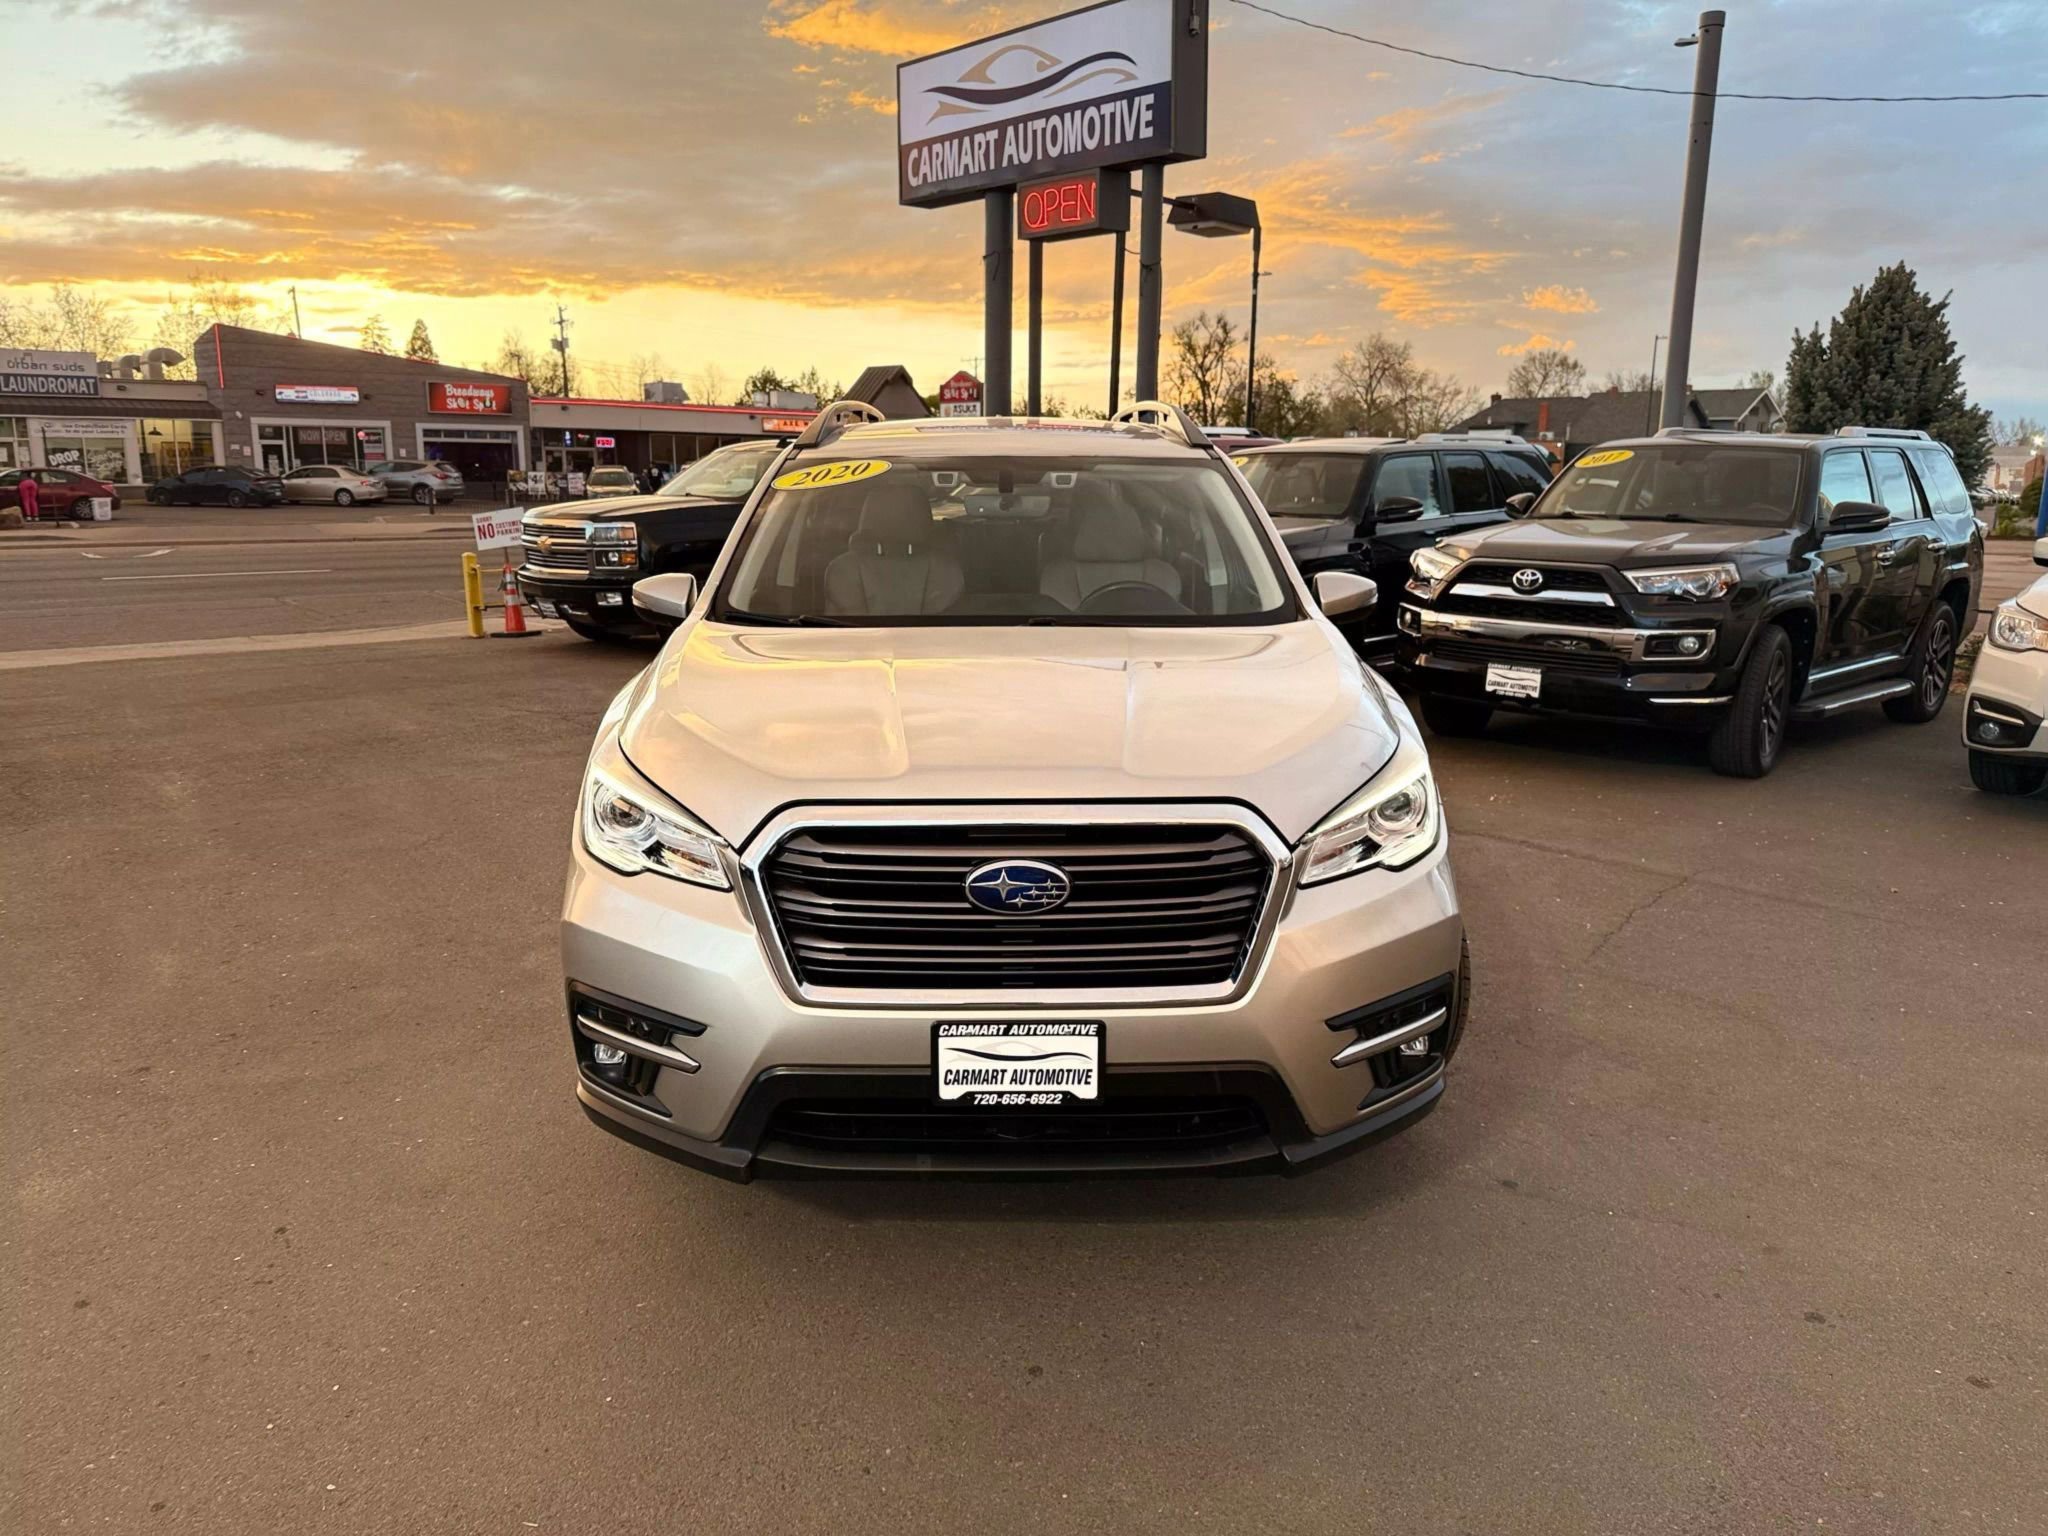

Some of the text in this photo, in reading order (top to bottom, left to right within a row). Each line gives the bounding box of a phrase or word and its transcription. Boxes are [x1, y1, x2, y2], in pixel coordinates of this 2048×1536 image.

[907, 93, 1154, 187] CARMART AUTOMOTIVE
[1024, 182, 1096, 228] OPEN
[52, 362, 85, 372] suds
[0, 375, 95, 394] LAUNDROMAT
[48, 450, 80, 467] DROP
[789, 462, 872, 487] 2020
[477, 523, 496, 541] NO
[939, 1024, 1098, 1036] CARMART AUTOMOTIVE
[944, 1068, 1093, 1086] CARMART AUTOMOTIVE
[973, 1093, 1063, 1106] 720-656-6922
